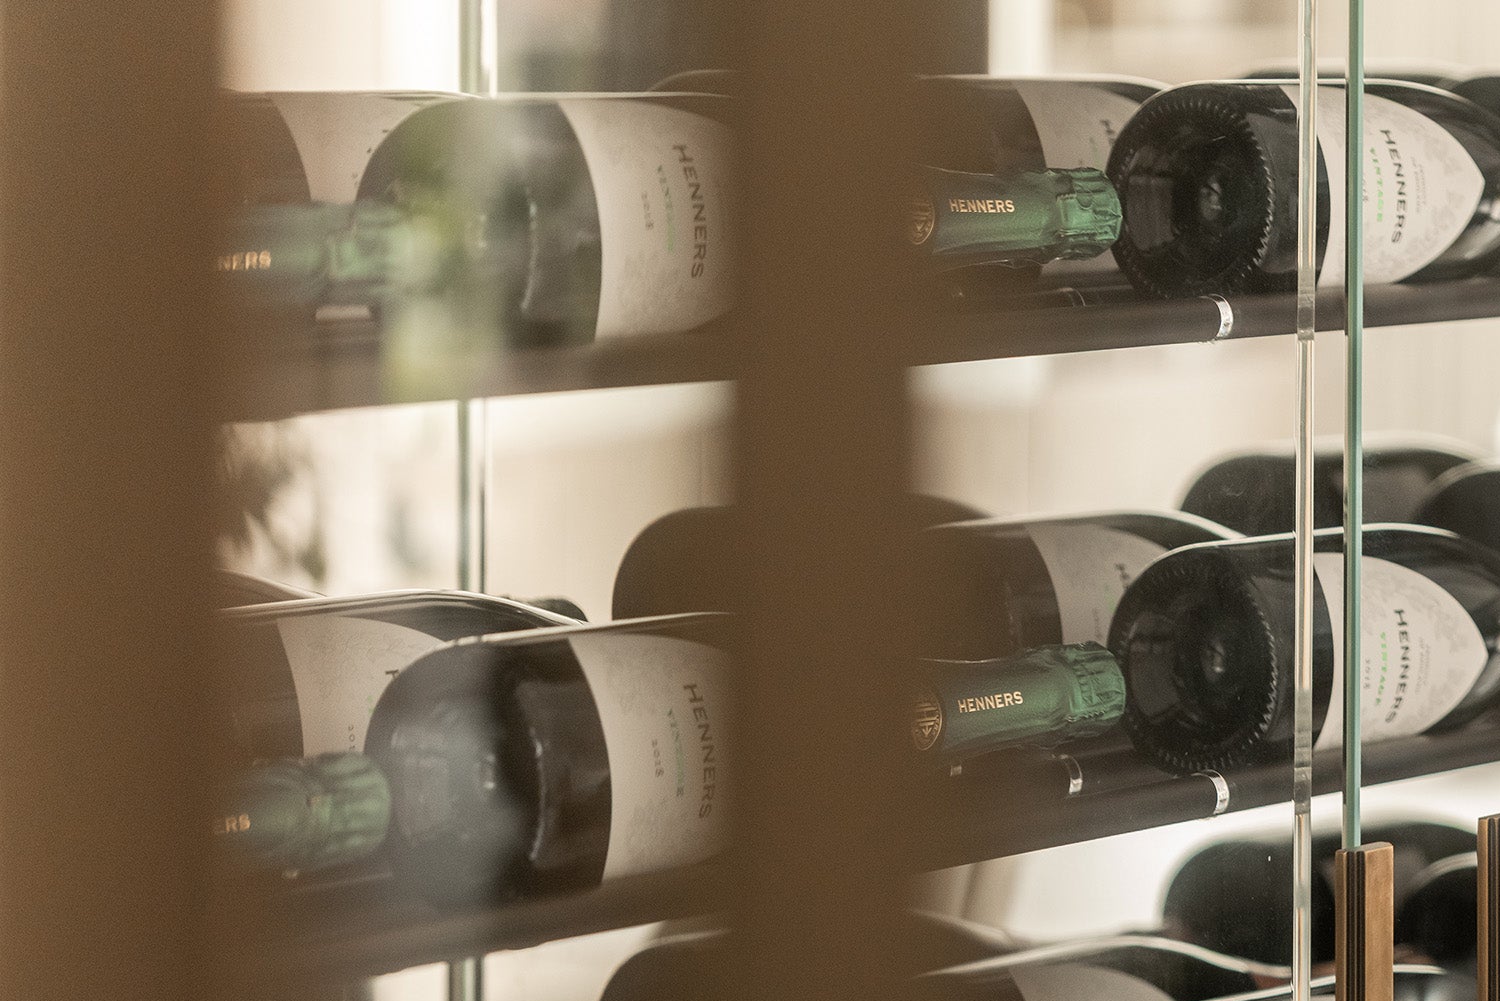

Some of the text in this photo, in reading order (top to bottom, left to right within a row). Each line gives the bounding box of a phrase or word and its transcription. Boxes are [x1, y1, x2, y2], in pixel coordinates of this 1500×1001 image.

[672, 144, 708, 279] HENNERS
[950, 199, 1015, 213] HENNERS
[1379, 129, 1408, 243] HENNERS
[957, 691, 1024, 713] HENNERS
[1385, 608, 1411, 723] HENNERS
[683, 684, 717, 819] HENNERS
